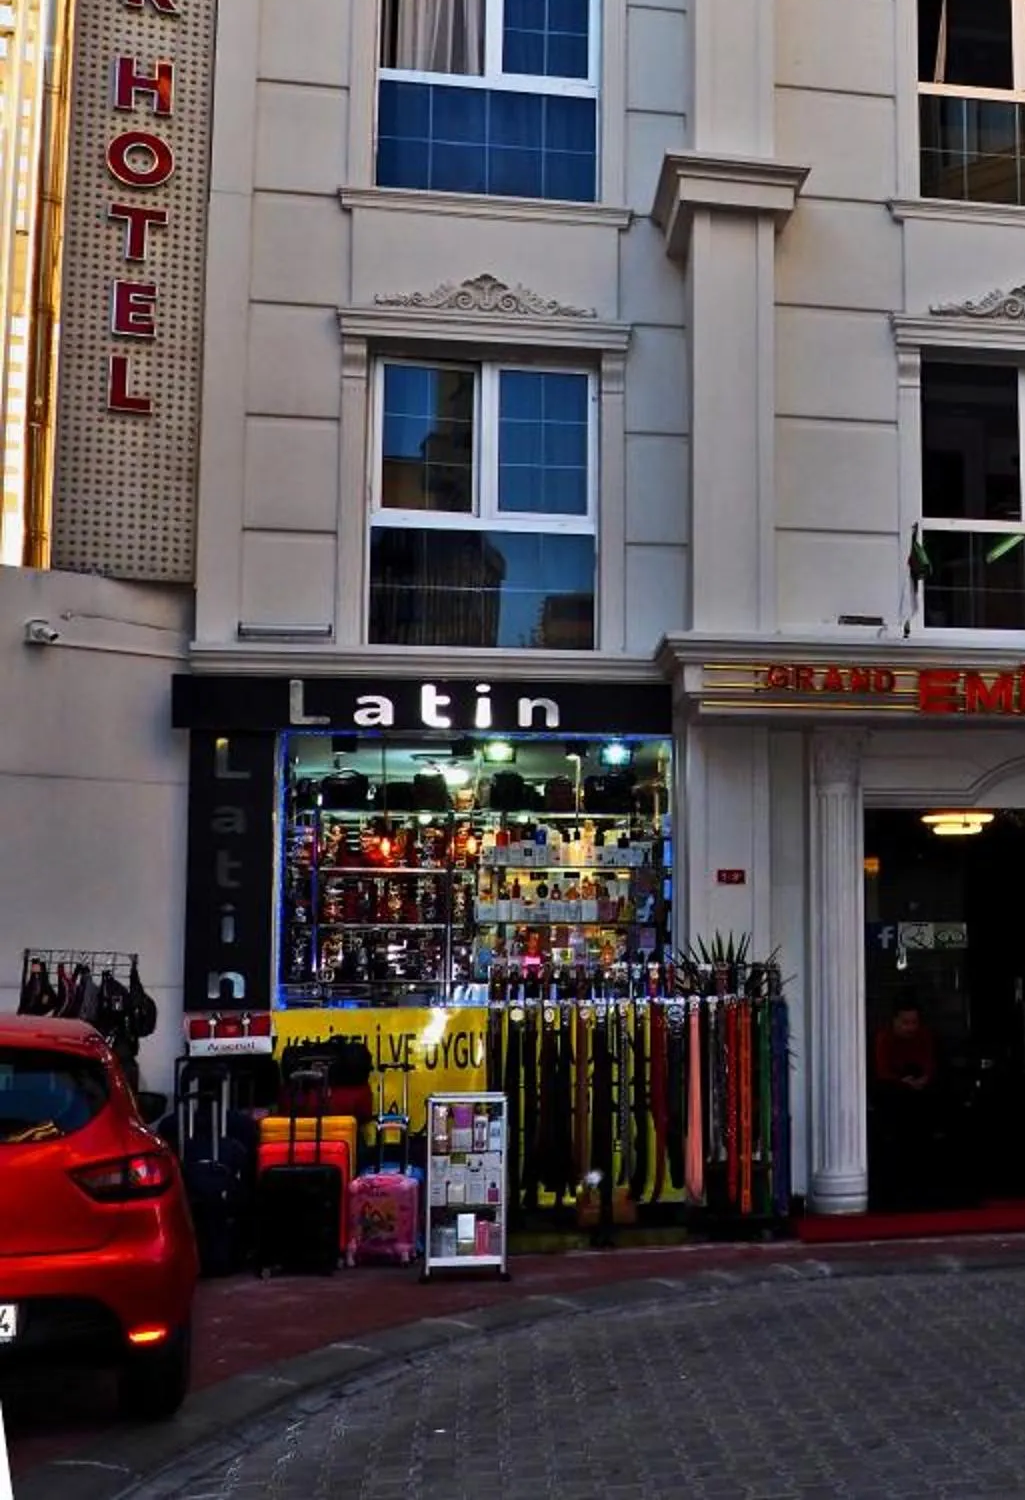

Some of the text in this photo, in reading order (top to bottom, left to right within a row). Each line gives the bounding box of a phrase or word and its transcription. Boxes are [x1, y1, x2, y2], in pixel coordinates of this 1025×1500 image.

[105, 54, 176, 415] HOTEL
[288, 679, 560, 728] Latin
[768, 663, 895, 693] GRAND
[207, 737, 252, 999] Latin
